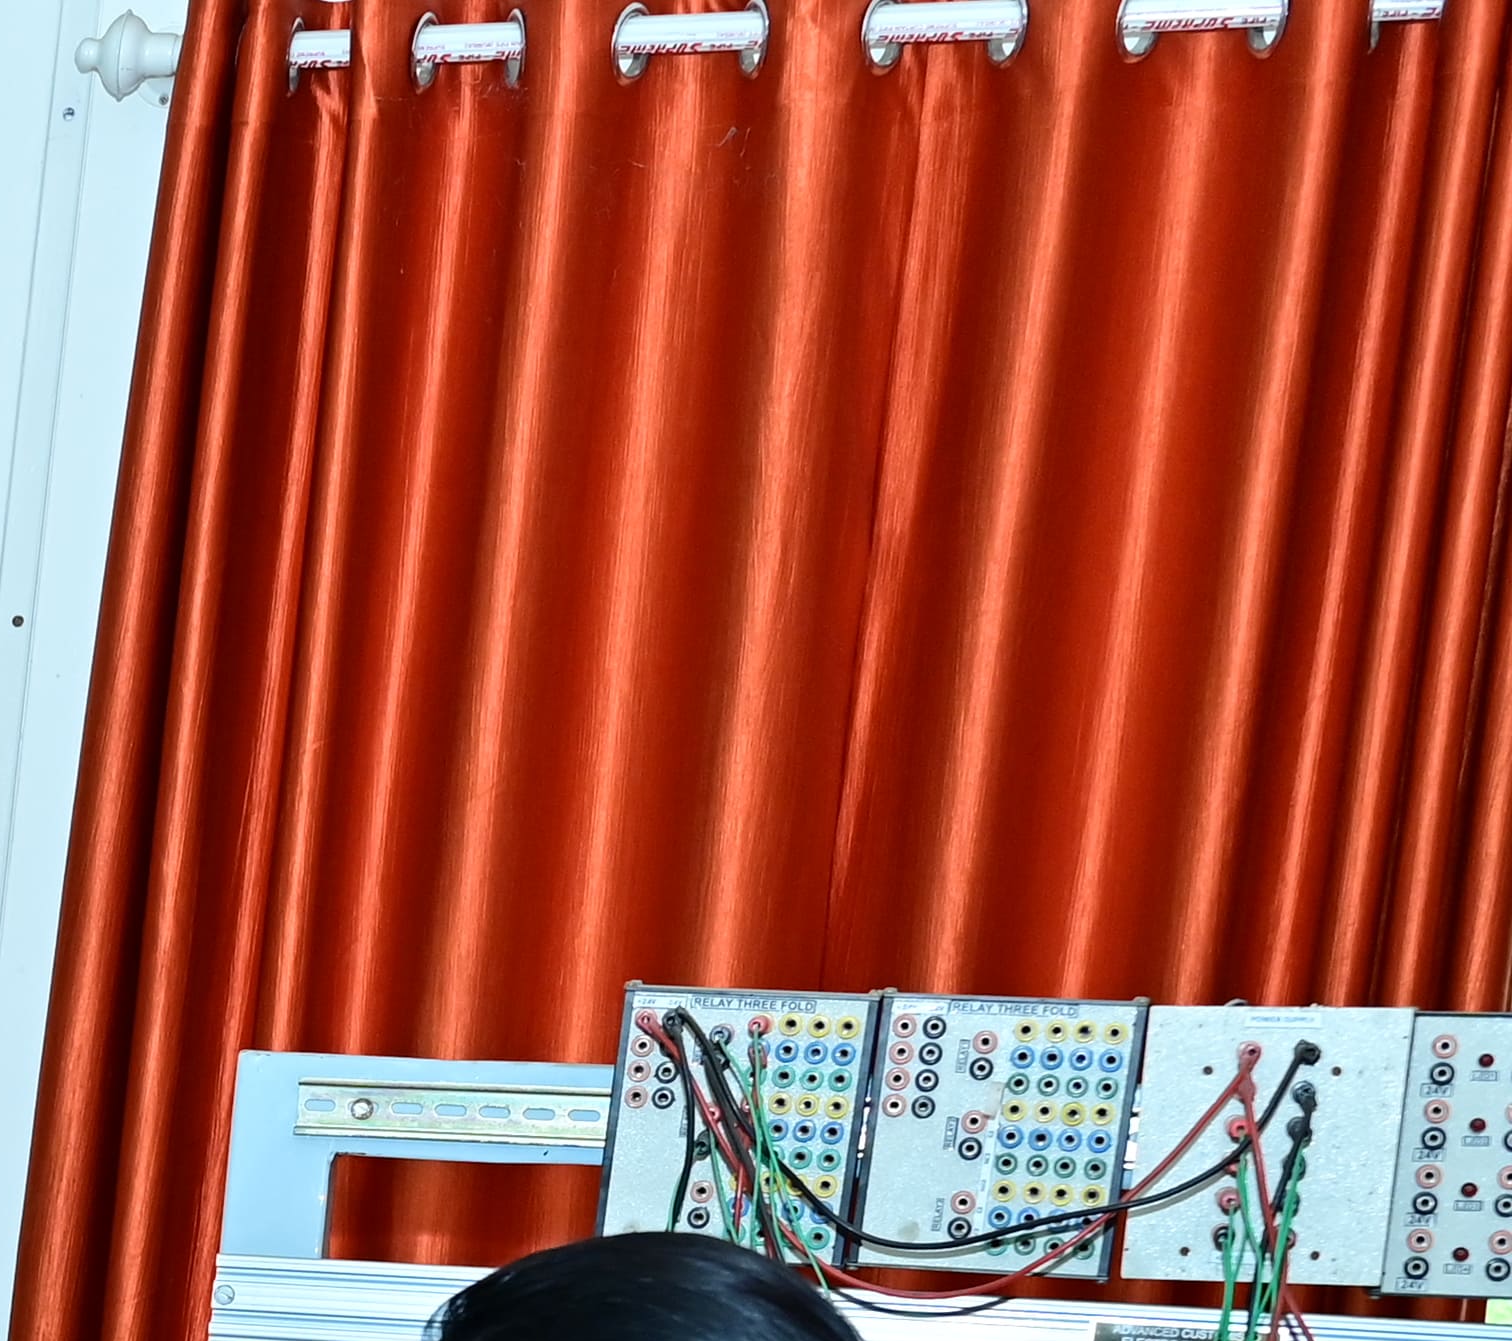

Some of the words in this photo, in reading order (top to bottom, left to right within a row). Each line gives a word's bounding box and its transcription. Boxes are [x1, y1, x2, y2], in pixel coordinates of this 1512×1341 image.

[692, 997, 734, 1008] RELAY
[738, 999, 778, 1010] THREE
[781, 1000, 814, 1012] FOLD
[954, 1002, 994, 1014] RELAY
[999, 1004, 1038, 1016] THREE
[1042, 1005, 1076, 1016] FOLD
[1426, 1086, 1448, 1094] 24V
[1418, 1151, 1440, 1160] 24V
[1409, 1215, 1430, 1224] 24V
[1401, 1280, 1424, 1288] 24V
[1112, 1325, 1180, 1338] ADVANCED
